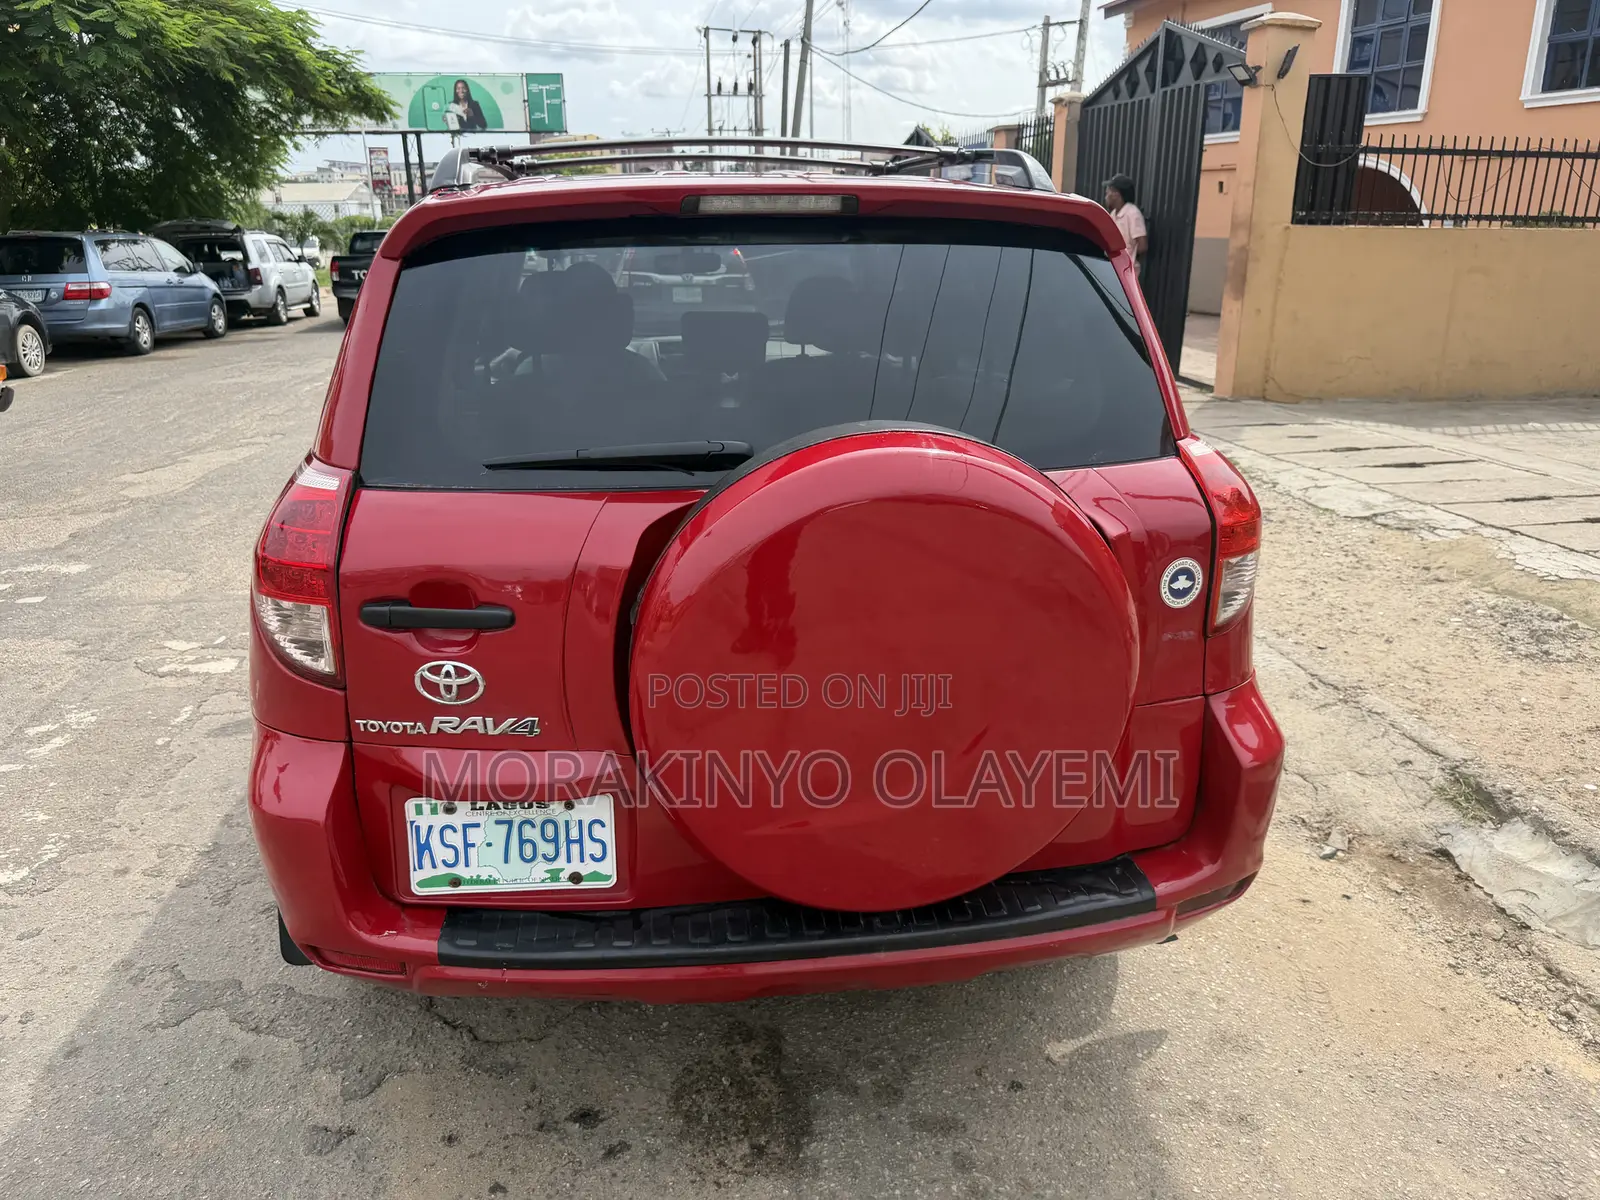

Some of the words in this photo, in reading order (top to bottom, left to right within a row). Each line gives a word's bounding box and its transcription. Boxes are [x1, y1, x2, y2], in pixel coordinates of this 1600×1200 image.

[1166, 561, 1188, 578] REDEEMED
[1188, 562, 1201, 586] CHRISTIAN
[355, 719, 428, 735] TOYOTA
[429, 716, 541, 738] RAV4
[465, 810, 496, 818] CENTRE
[508, 809, 557, 817] EXCELLENCE
